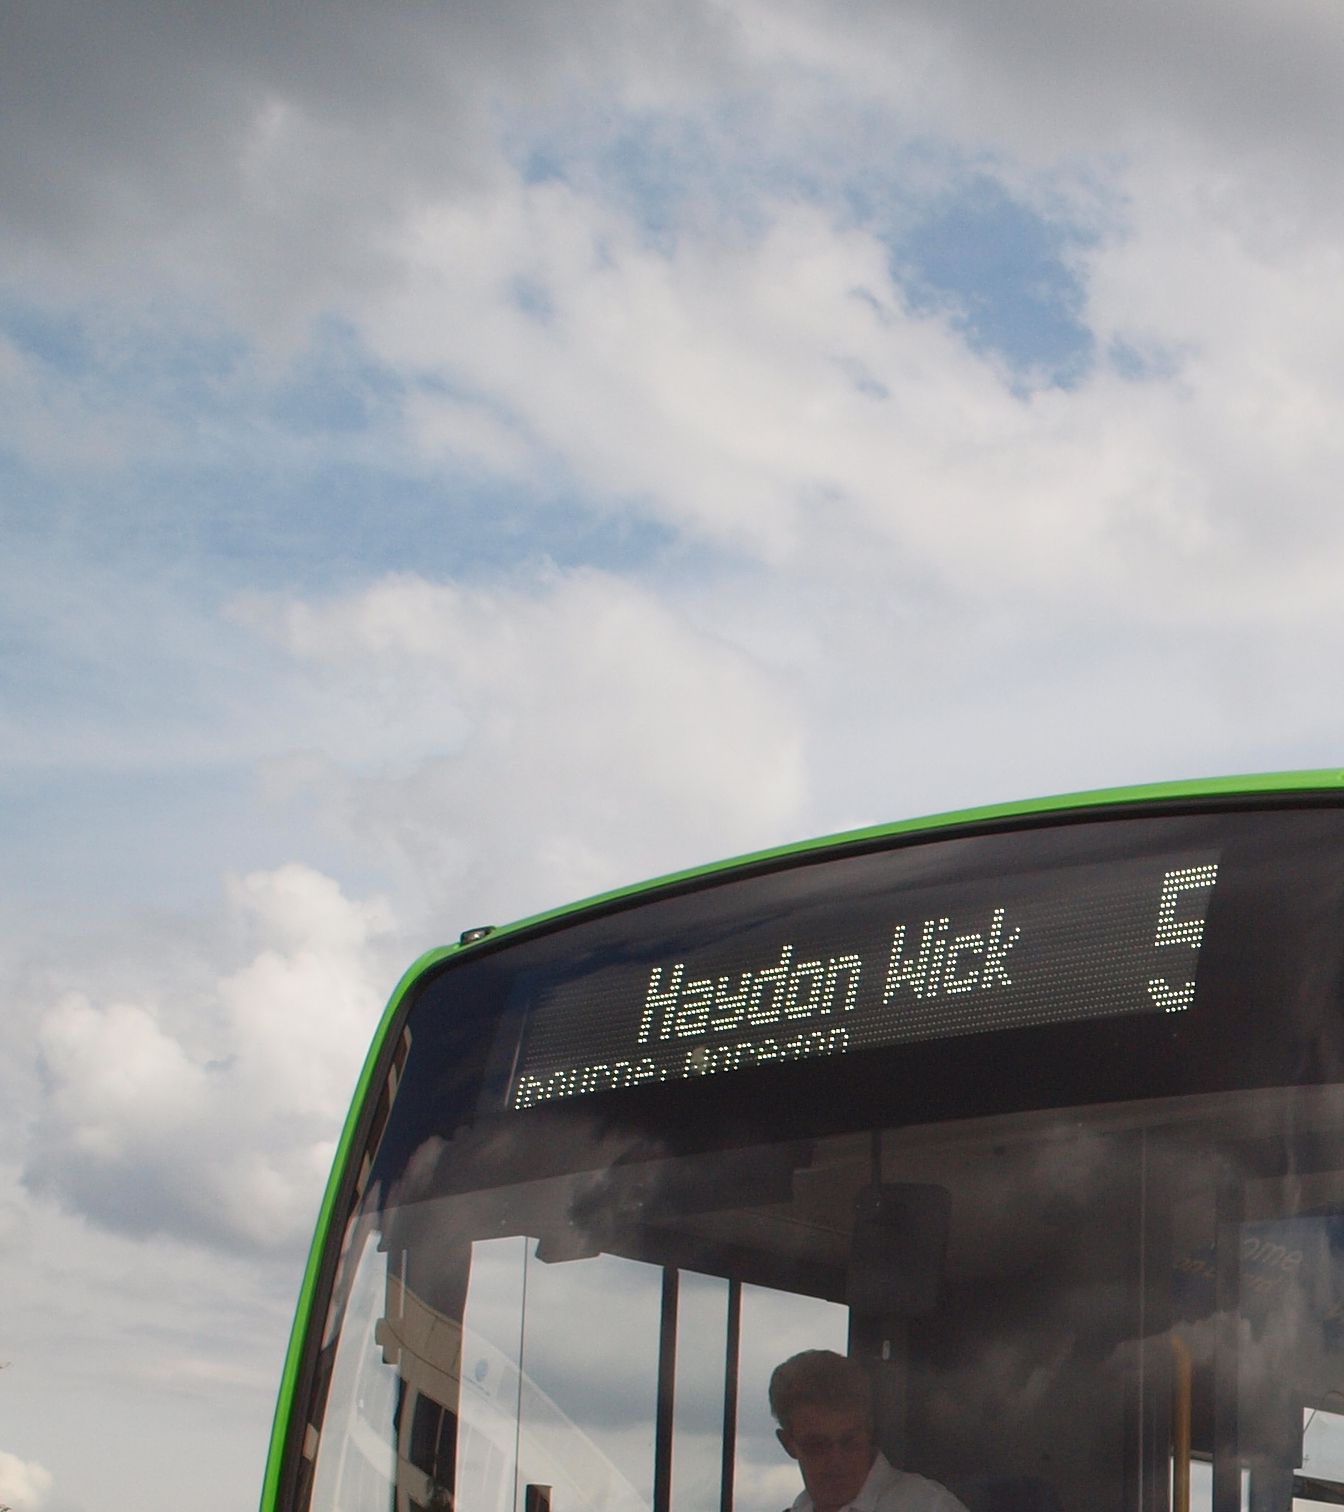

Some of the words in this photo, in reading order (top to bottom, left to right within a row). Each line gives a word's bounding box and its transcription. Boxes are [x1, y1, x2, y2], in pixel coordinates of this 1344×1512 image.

[637, 944, 863, 1044] Haydon
[883, 908, 1021, 1004] Wick
[1148, 864, 1219, 1013] 5
